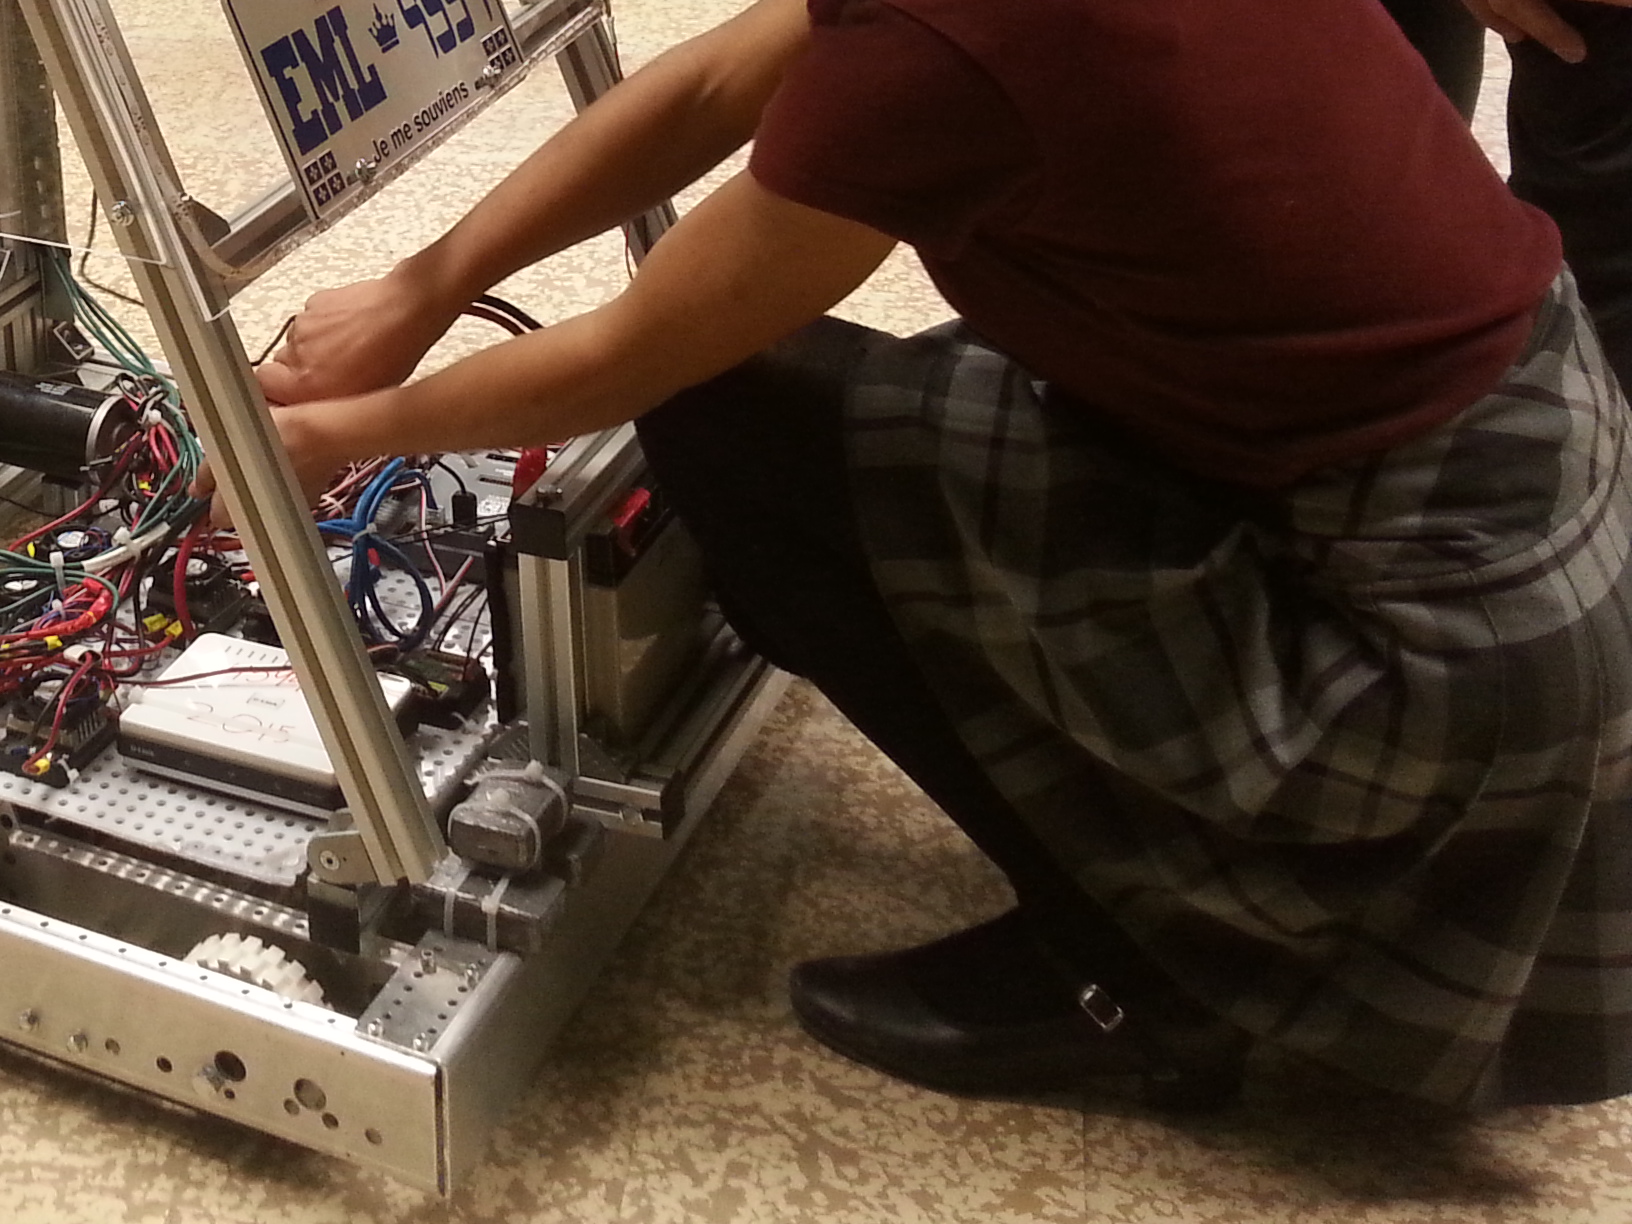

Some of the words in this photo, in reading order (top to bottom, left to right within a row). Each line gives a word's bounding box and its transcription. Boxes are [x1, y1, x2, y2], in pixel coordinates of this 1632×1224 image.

[260, 5, 388, 156] EML
[372, 137, 389, 164] Je
[390, 122, 414, 151] me
[413, 79, 469, 134] souviens
